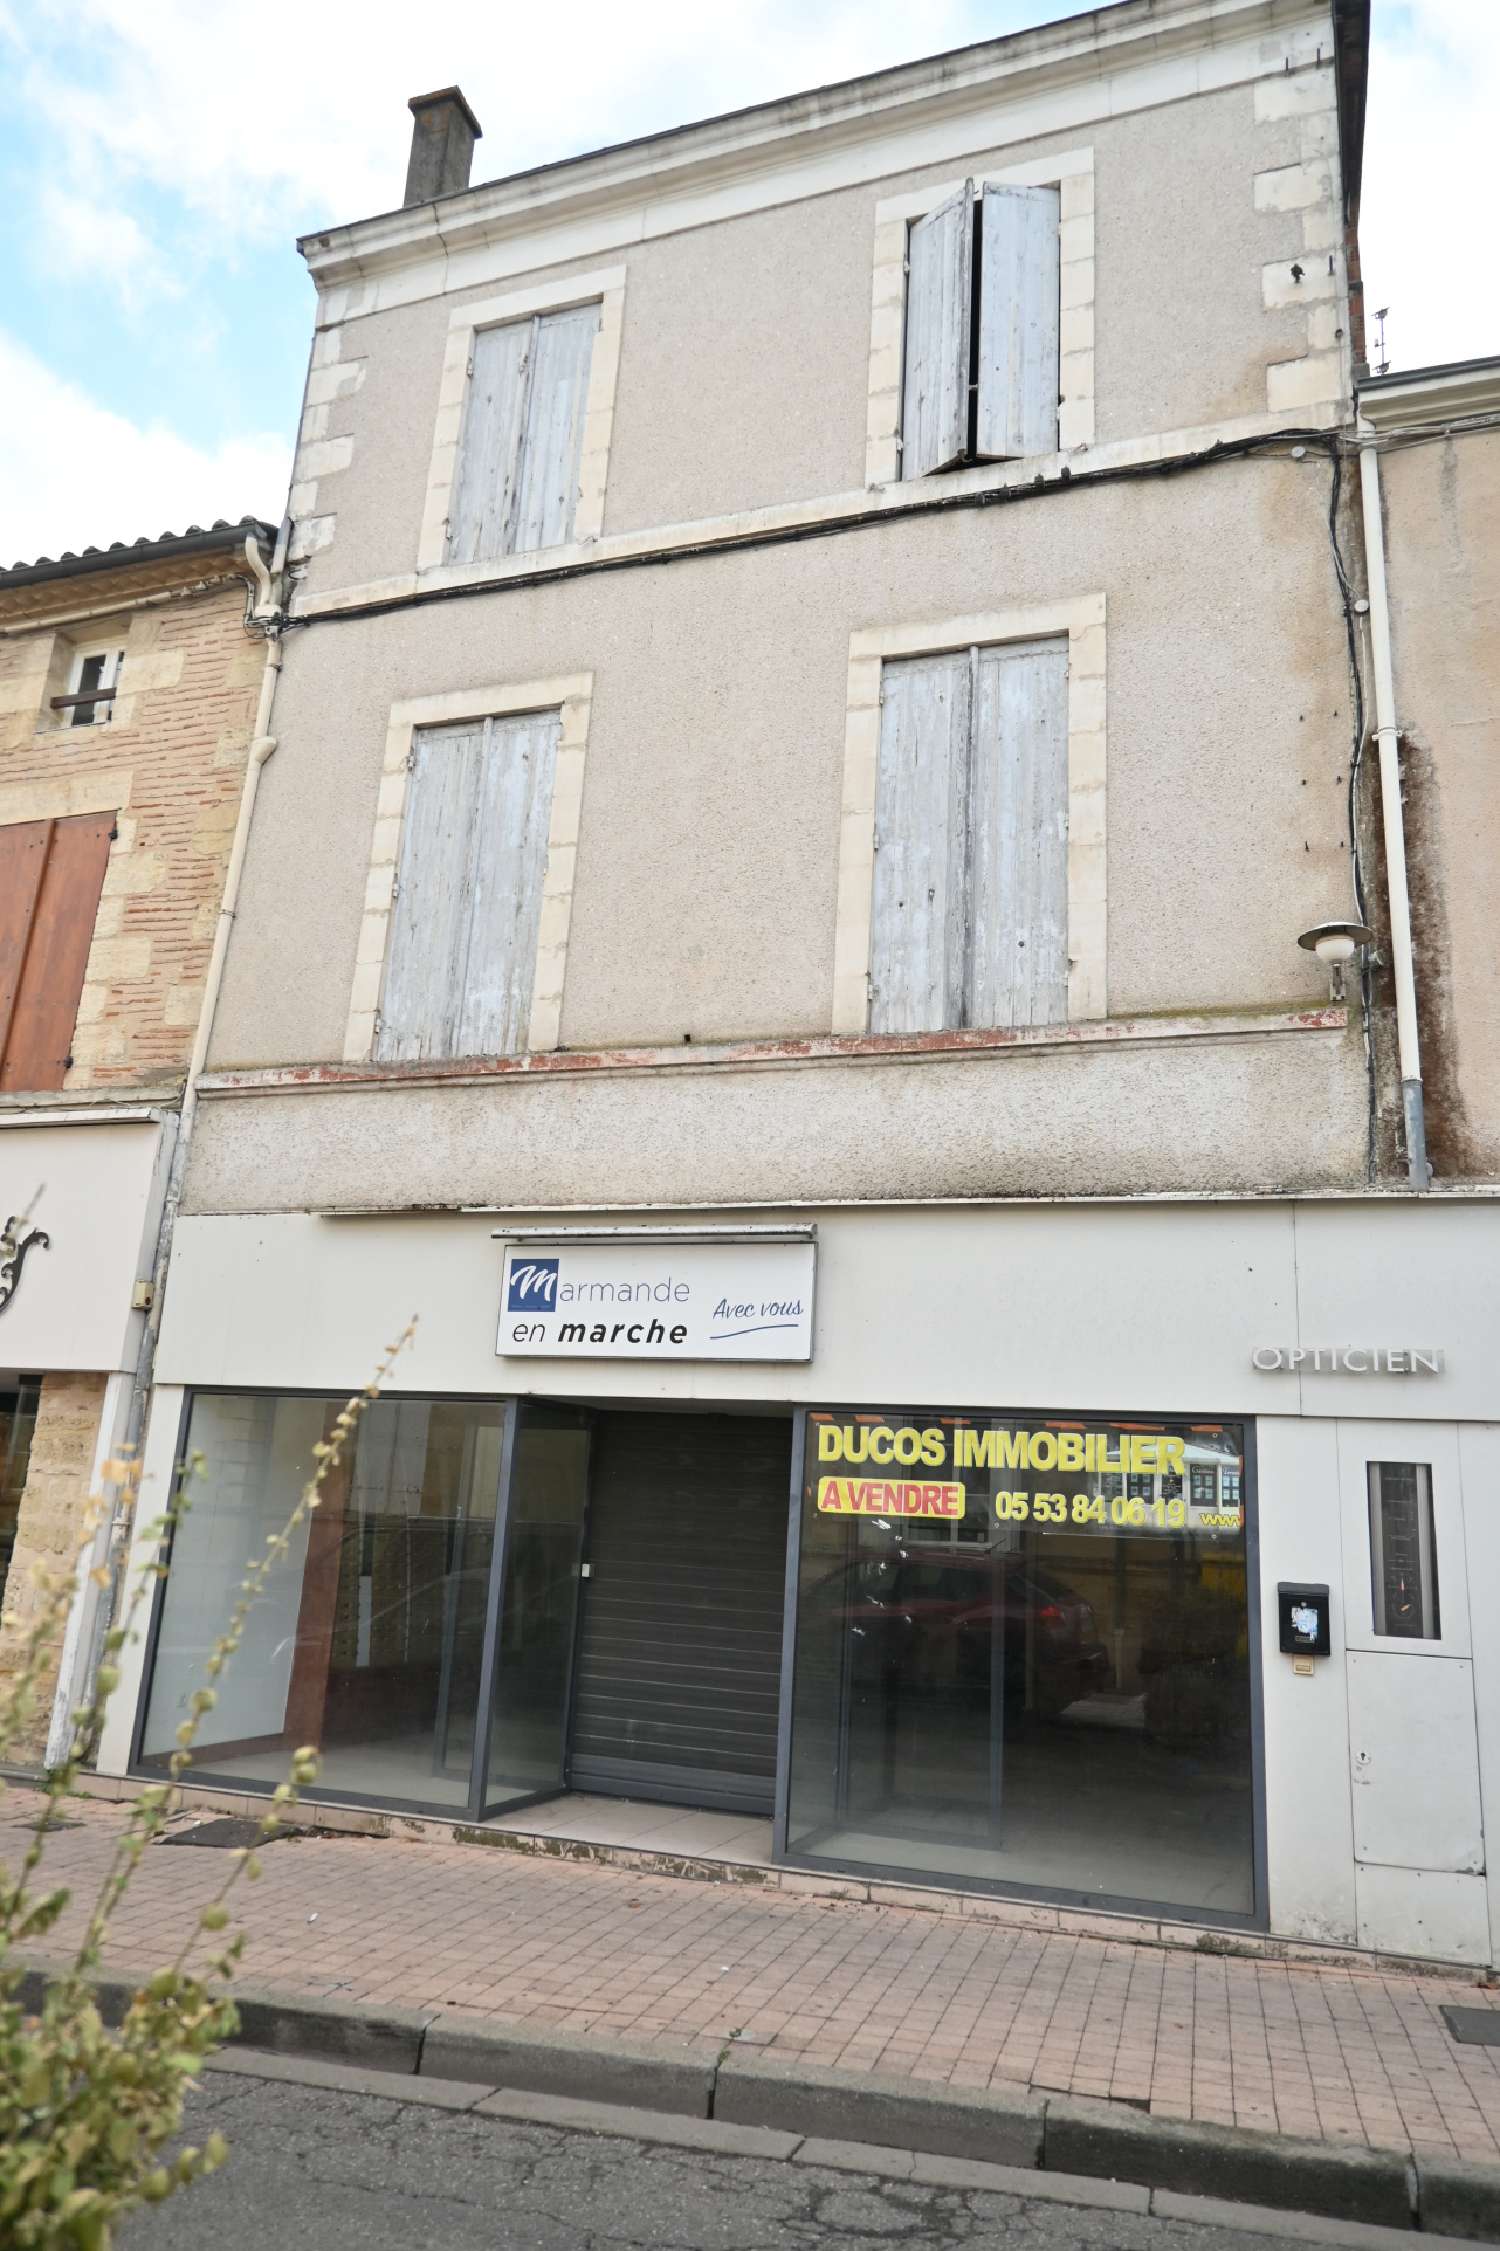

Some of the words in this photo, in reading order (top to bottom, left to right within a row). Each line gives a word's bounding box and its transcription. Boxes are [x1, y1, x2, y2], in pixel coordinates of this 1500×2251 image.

[712, 1299, 755, 1319] Avec
[760, 1300, 804, 1317] vous
[512, 1322, 546, 1343] en
[557, 1319, 688, 1344] marche
[1252, 1348, 1440, 1374] OPTICIEN
[818, 1425, 946, 1466] DUCOS
[953, 1430, 1186, 1474] IMMOBILIER
[821, 1481, 842, 1512] A
[846, 1482, 959, 1516] VENDRE
[995, 1491, 1029, 1521] 05
[1032, 1492, 1067, 1523] 53
[1071, 1494, 1107, 1525] 84
[1111, 1496, 1147, 1526] 06
[1151, 1498, 1185, 1529] 19
